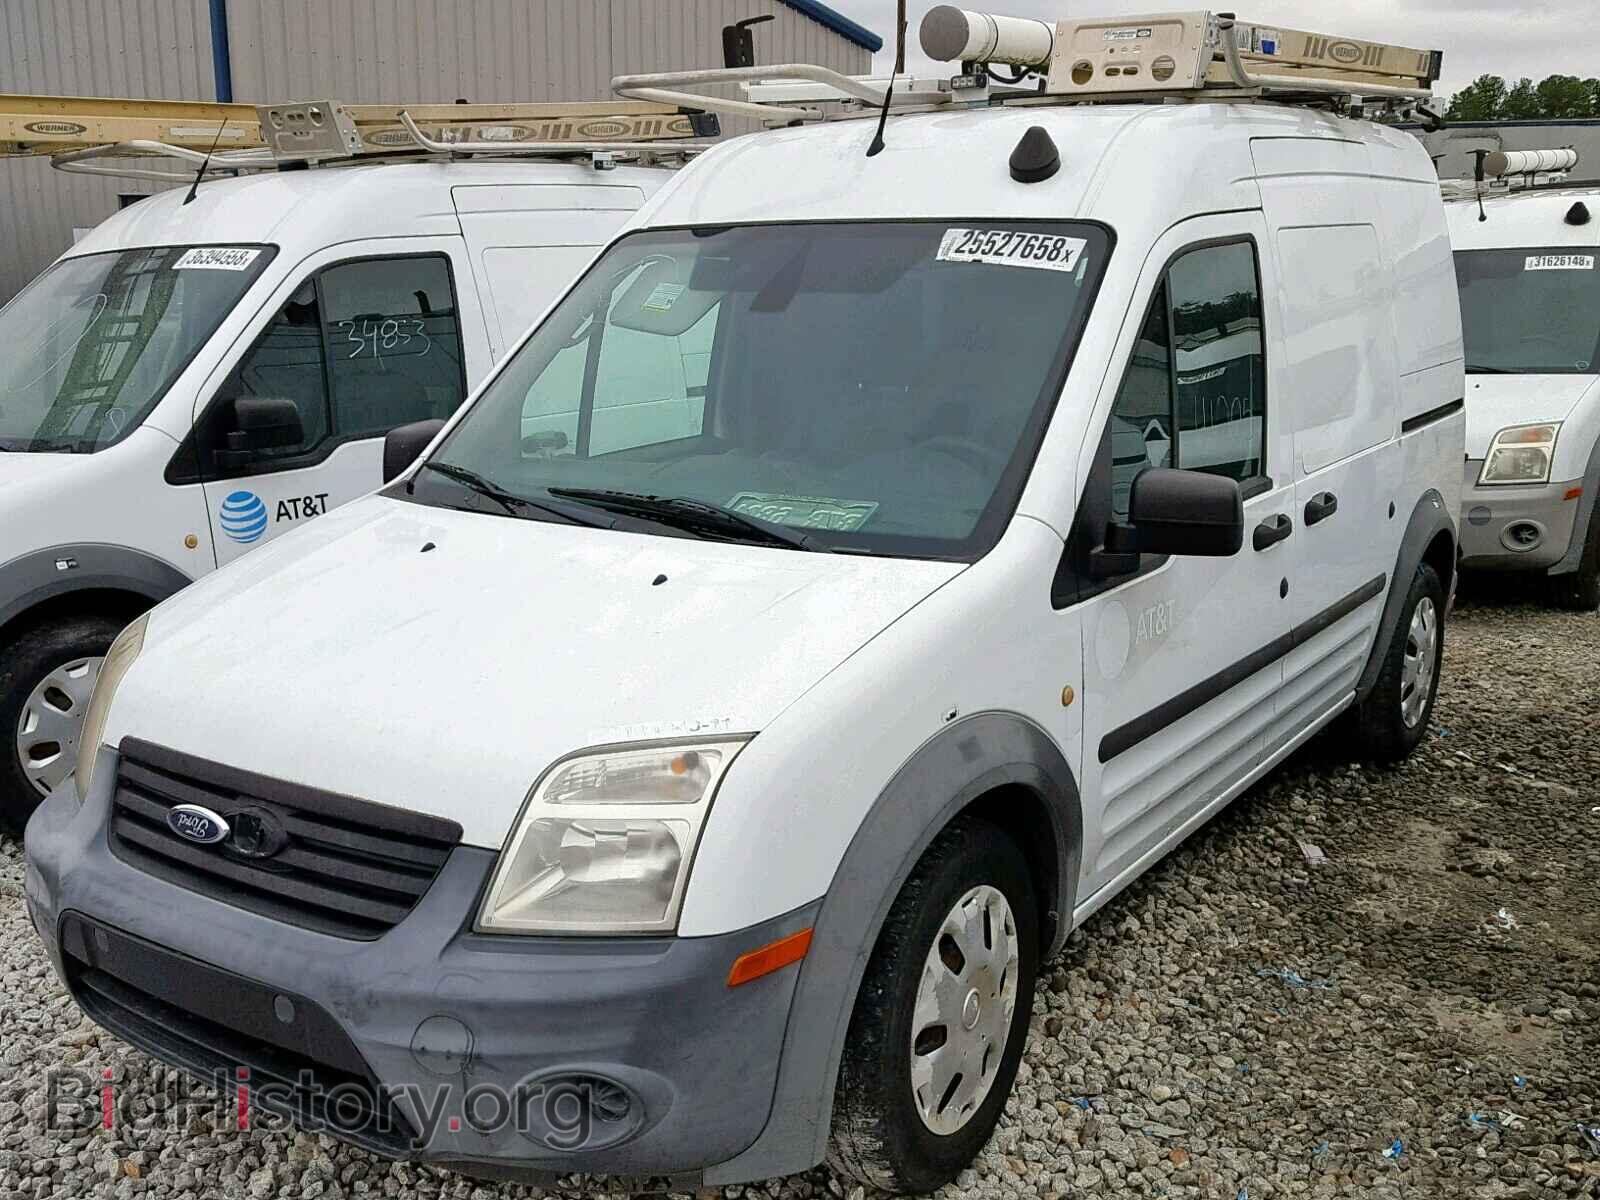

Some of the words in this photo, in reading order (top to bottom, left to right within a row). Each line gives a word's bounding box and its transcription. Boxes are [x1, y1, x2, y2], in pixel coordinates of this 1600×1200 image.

[36, 124, 77, 132] WERNER
[338, 319, 431, 358] 34853
[275, 493, 329, 522] AT&T
[1135, 600, 1175, 645] AT&T
[177, 813, 209, 838] Ford
